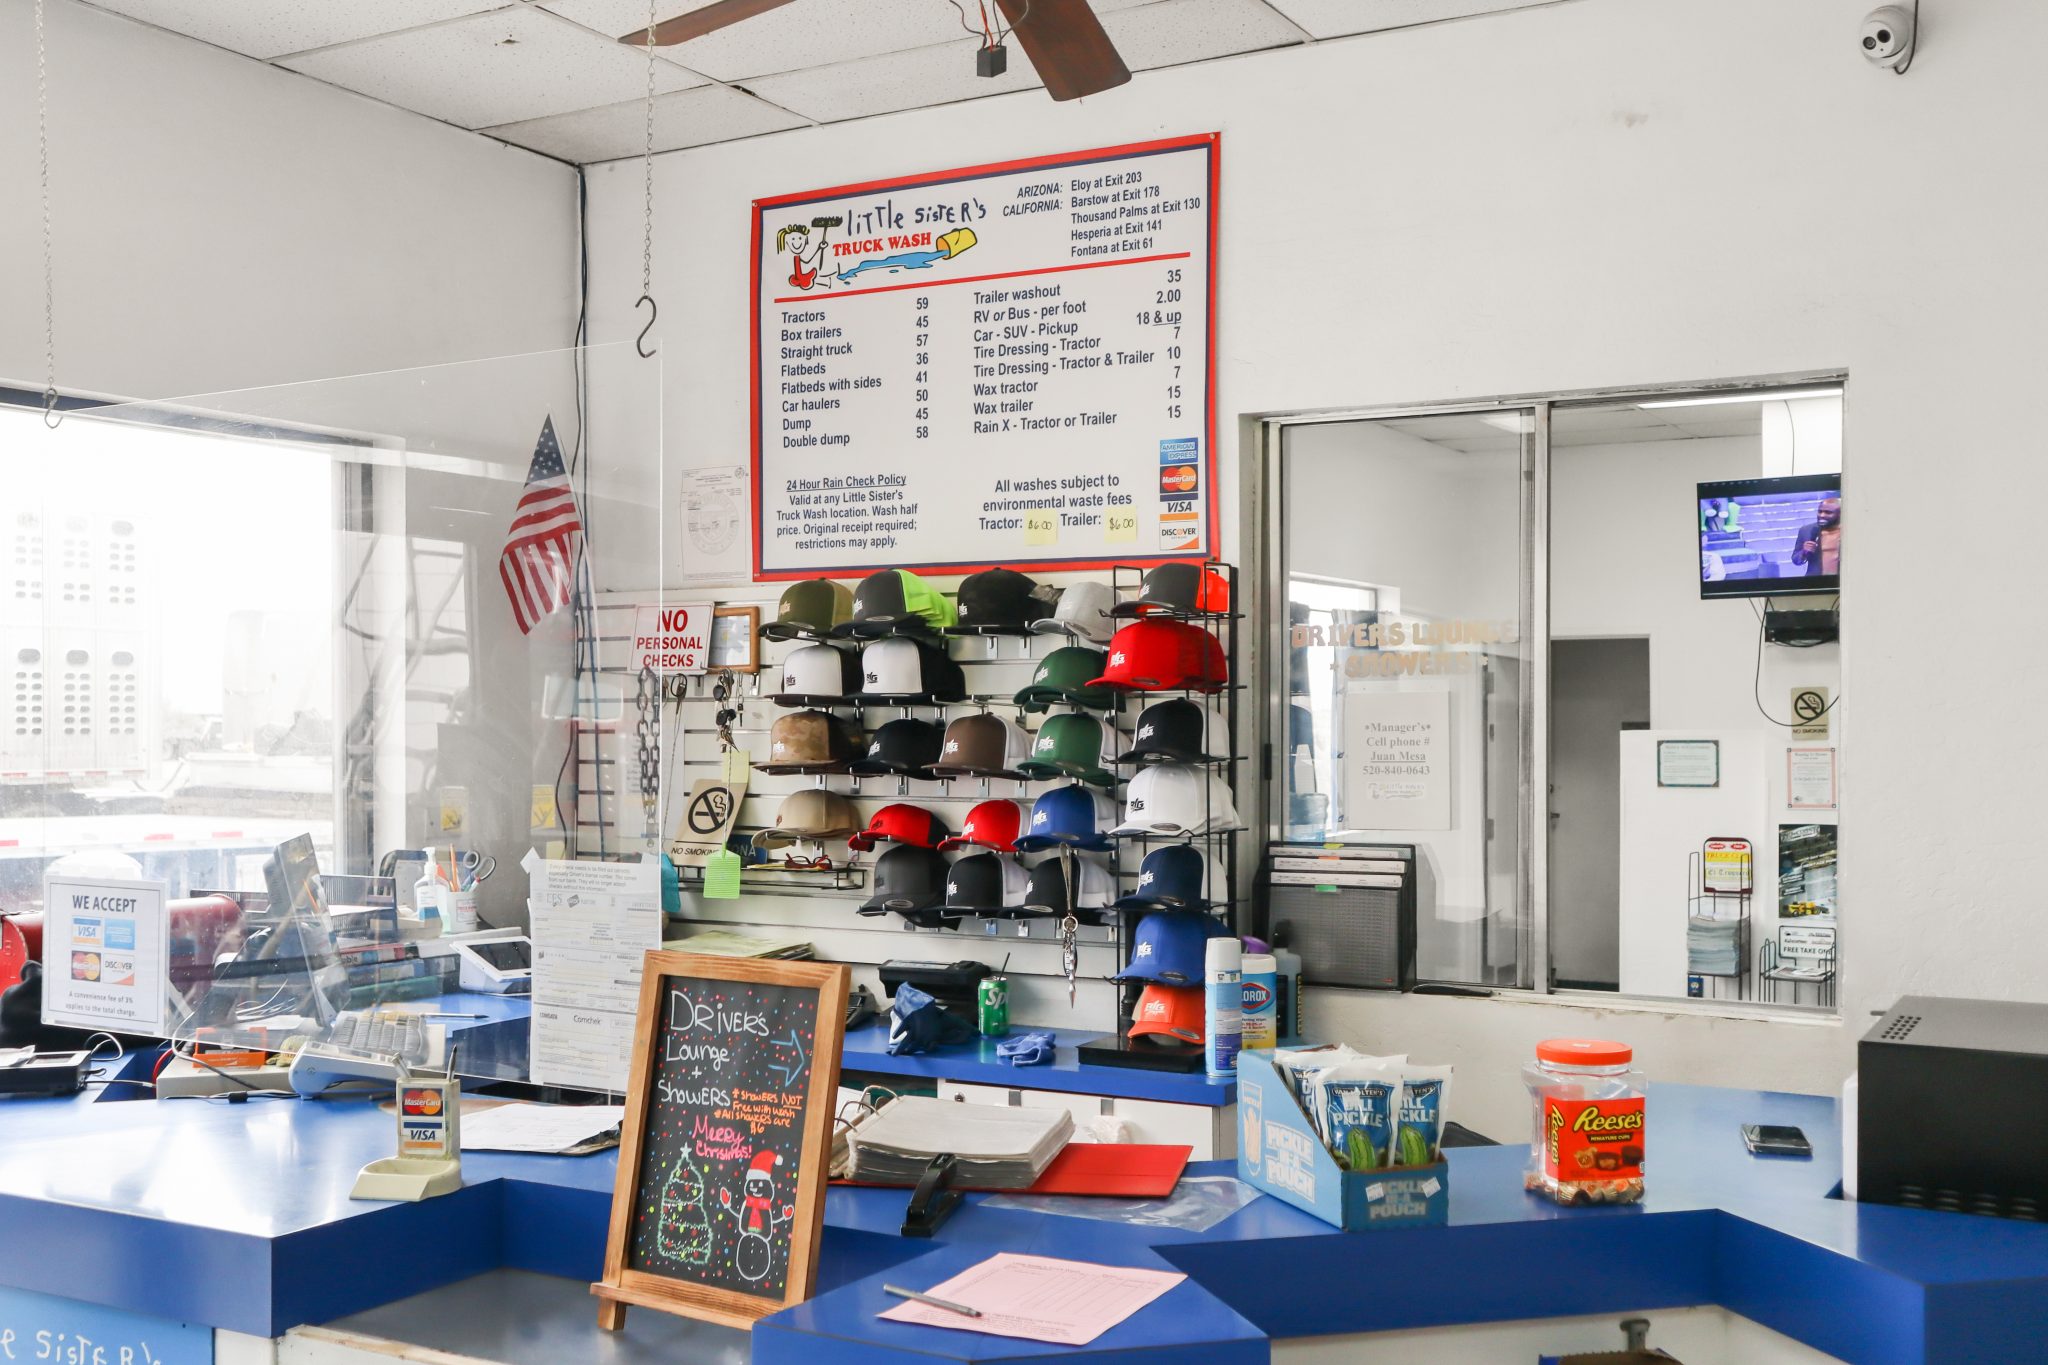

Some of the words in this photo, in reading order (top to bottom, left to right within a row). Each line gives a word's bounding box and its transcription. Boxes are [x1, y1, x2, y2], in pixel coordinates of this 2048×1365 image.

[1017, 182, 1063, 199] ARIZONA:
[1071, 179, 1091, 192] Eloy
[1094, 177, 1103, 188] at
[1105, 174, 1123, 187] Exit
[1126, 171, 1142, 184] 203
[1003, 199, 1063, 217] CALIFORNIA:
[1071, 195, 1109, 208] Barstow
[1111, 191, 1120, 203] at
[1123, 188, 1141, 201] Exit
[1144, 185, 1160, 198] 178
[1071, 208, 1117, 224] Thousand
[1120, 205, 1148, 218] Palms
[1151, 203, 1160, 214] at
[1163, 200, 1181, 213] Exit
[1184, 197, 1200, 210] 130
[832, 238, 884, 257] TRUCK
[887, 232, 931, 250] WASH
[974, 290, 1009, 304] Trailer
[1012, 284, 1060, 300] washout
[1167, 269, 1181, 283] 35
[781, 311, 825, 324] Tractors
[916, 297, 929, 310] 59
[974, 310, 990, 323] RV
[993, 311, 1006, 321] or
[1008, 307, 1030, 320] Bus
[1041, 305, 1060, 320] per
[1063, 301, 1086, 314] foot
[1156, 289, 1181, 304] 2.00
[974, 329, 993, 342] Car
[1004, 325, 1028, 339] SUV
[1039, 321, 1078, 336] Pickup
[1136, 312, 1150, 325] 18
[1154, 310, 1162, 323] &
[1167, 312, 1182, 325] up
[781, 345, 823, 361] Straight
[826, 342, 853, 356] truck
[916, 334, 928, 347] 57
[974, 365, 995, 377] Tire
[998, 360, 1049, 375] Dressing
[1060, 356, 1101, 370] Tractor
[1104, 353, 1113, 366] &
[1116, 350, 1154, 365] Trailer
[1167, 346, 1181, 359] 10
[782, 380, 825, 395] Flatbeds
[828, 378, 850, 391] with
[854, 376, 882, 389] sides
[916, 371, 927, 383] 41
[974, 420, 999, 434] Rain
[1002, 419, 1010, 431] X
[1020, 417, 1061, 430] Tractor
[1064, 417, 1076, 427] or
[1080, 412, 1117, 426] Trailer
[1168, 405, 1181, 418] 15
[783, 434, 817, 448] Double
[820, 433, 850, 447] dump
[916, 426, 928, 439] 58
[787, 480, 797, 491] 24
[799, 479, 820, 489] Hour
[823, 477, 843, 488] Rain
[846, 475, 875, 487] Check
[878, 473, 907, 486] Policy
[995, 479, 1010, 492] All
[1013, 478, 1057, 491] washes
[1061, 475, 1104, 491] subject
[1108, 474, 1119, 486] to
[789, 494, 811, 505] Valid
[813, 495, 821, 504] at
[824, 495, 840, 506] any
[843, 492, 866, 503] Little
[869, 489, 903, 501] Sister's
[983, 495, 1065, 512] environmental
[1069, 494, 1103, 507] waste
[1107, 492, 1132, 505] fees
[777, 510, 800, 520] Truck
[803, 508, 827, 519] Wash
[830, 507, 869, 518] location.
[872, 505, 897, 516] Wash
[900, 503, 918, 515] half
[1167, 501, 1193, 513] VISA
[777, 525, 801, 538] price.
[803, 523, 839, 536] Original
[842, 521, 873, 534] receipt
[875, 519, 917, 533] required;
[979, 517, 1022, 530] Tractor:
[1060, 513, 1101, 526] Trailer:
[795, 538, 846, 549] restrictions
[849, 539, 868, 549] may
[870, 535, 898, 548] apply.
[657, 609, 688, 632] NO
[636, 636, 703, 649] PERSONAL
[1291, 622, 1405, 648] DRIVERS
[643, 654, 694, 668] CHECKS
[1367, 737, 1386, 746] Cell
[1390, 737, 1421, 749] phone
[1424, 737, 1430, 745] #
[1371, 751, 1395, 761] Juan
[1400, 751, 1426, 761] Mesa
[1362, 765, 1430, 775] 520-840-0643
[684, 848, 719, 856] SMOKIN
[73, 895, 90, 909] WE
[93, 897, 136, 912] ACCEPT
[78, 927, 96, 936] VISA
[1242, 990, 1267, 1001] OROX
[666, 1035, 730, 1071] Lounge
[404, 1099, 440, 1107] MasterCard
[781, 1092, 803, 1105] NOT
[722, 1109, 734, 1119] All
[774, 1117, 791, 1128] are
[733, 1101, 752, 1111] Free
[753, 1105, 771, 1114] with
[773, 1107, 795, 1118] wash
[1333, 1113, 1384, 1127] PICKLE
[1573, 1106, 1643, 1132] Reese's
[410, 1130, 436, 1141] VISA
[1370, 1202, 1426, 1220] POUCH
